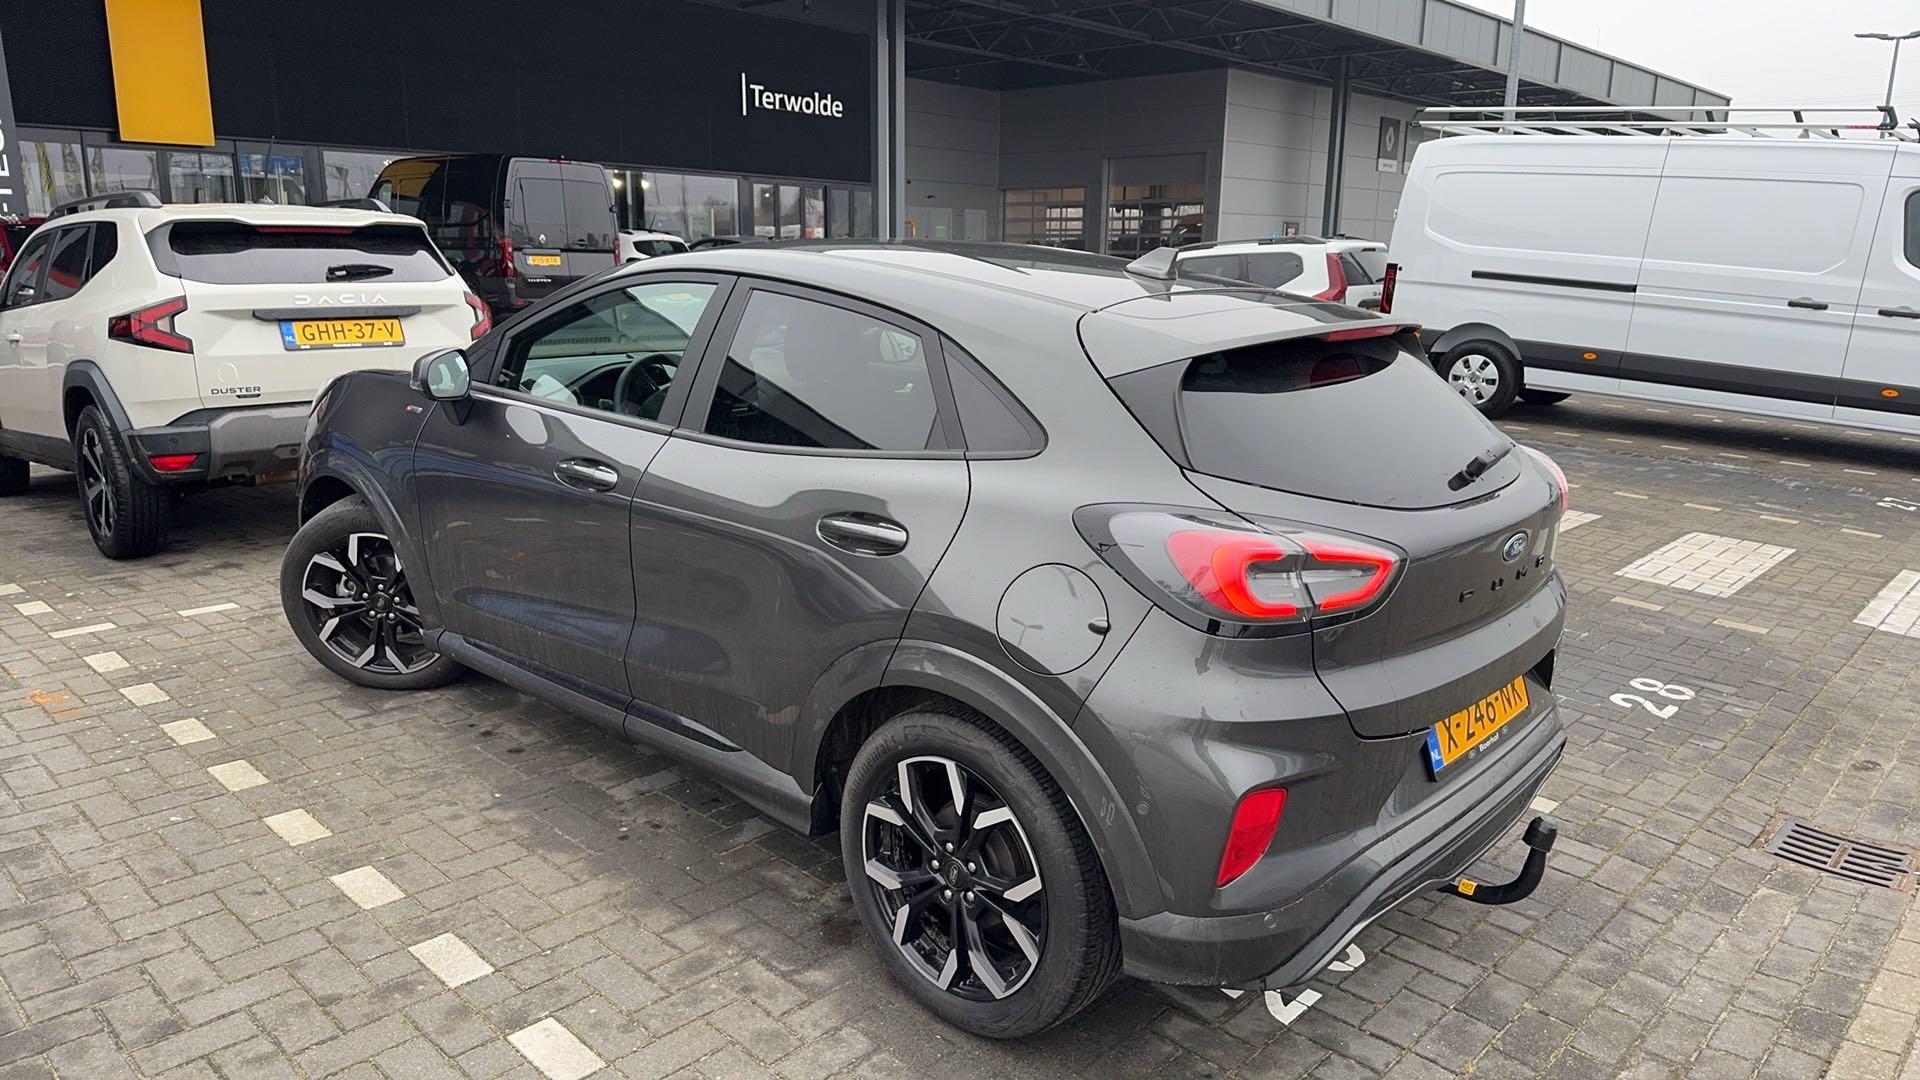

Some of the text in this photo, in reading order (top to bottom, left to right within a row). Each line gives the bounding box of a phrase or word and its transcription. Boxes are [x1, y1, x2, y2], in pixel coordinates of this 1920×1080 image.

[749, 84, 843, 117] Terwolde
[293, 293, 388, 304] DACIA
[302, 322, 395, 341] GHH-37-V
[211, 386, 261, 395] DUSTER
[1609, 678, 1695, 719] 28
[1441, 680, 1523, 753] X-246-NK
